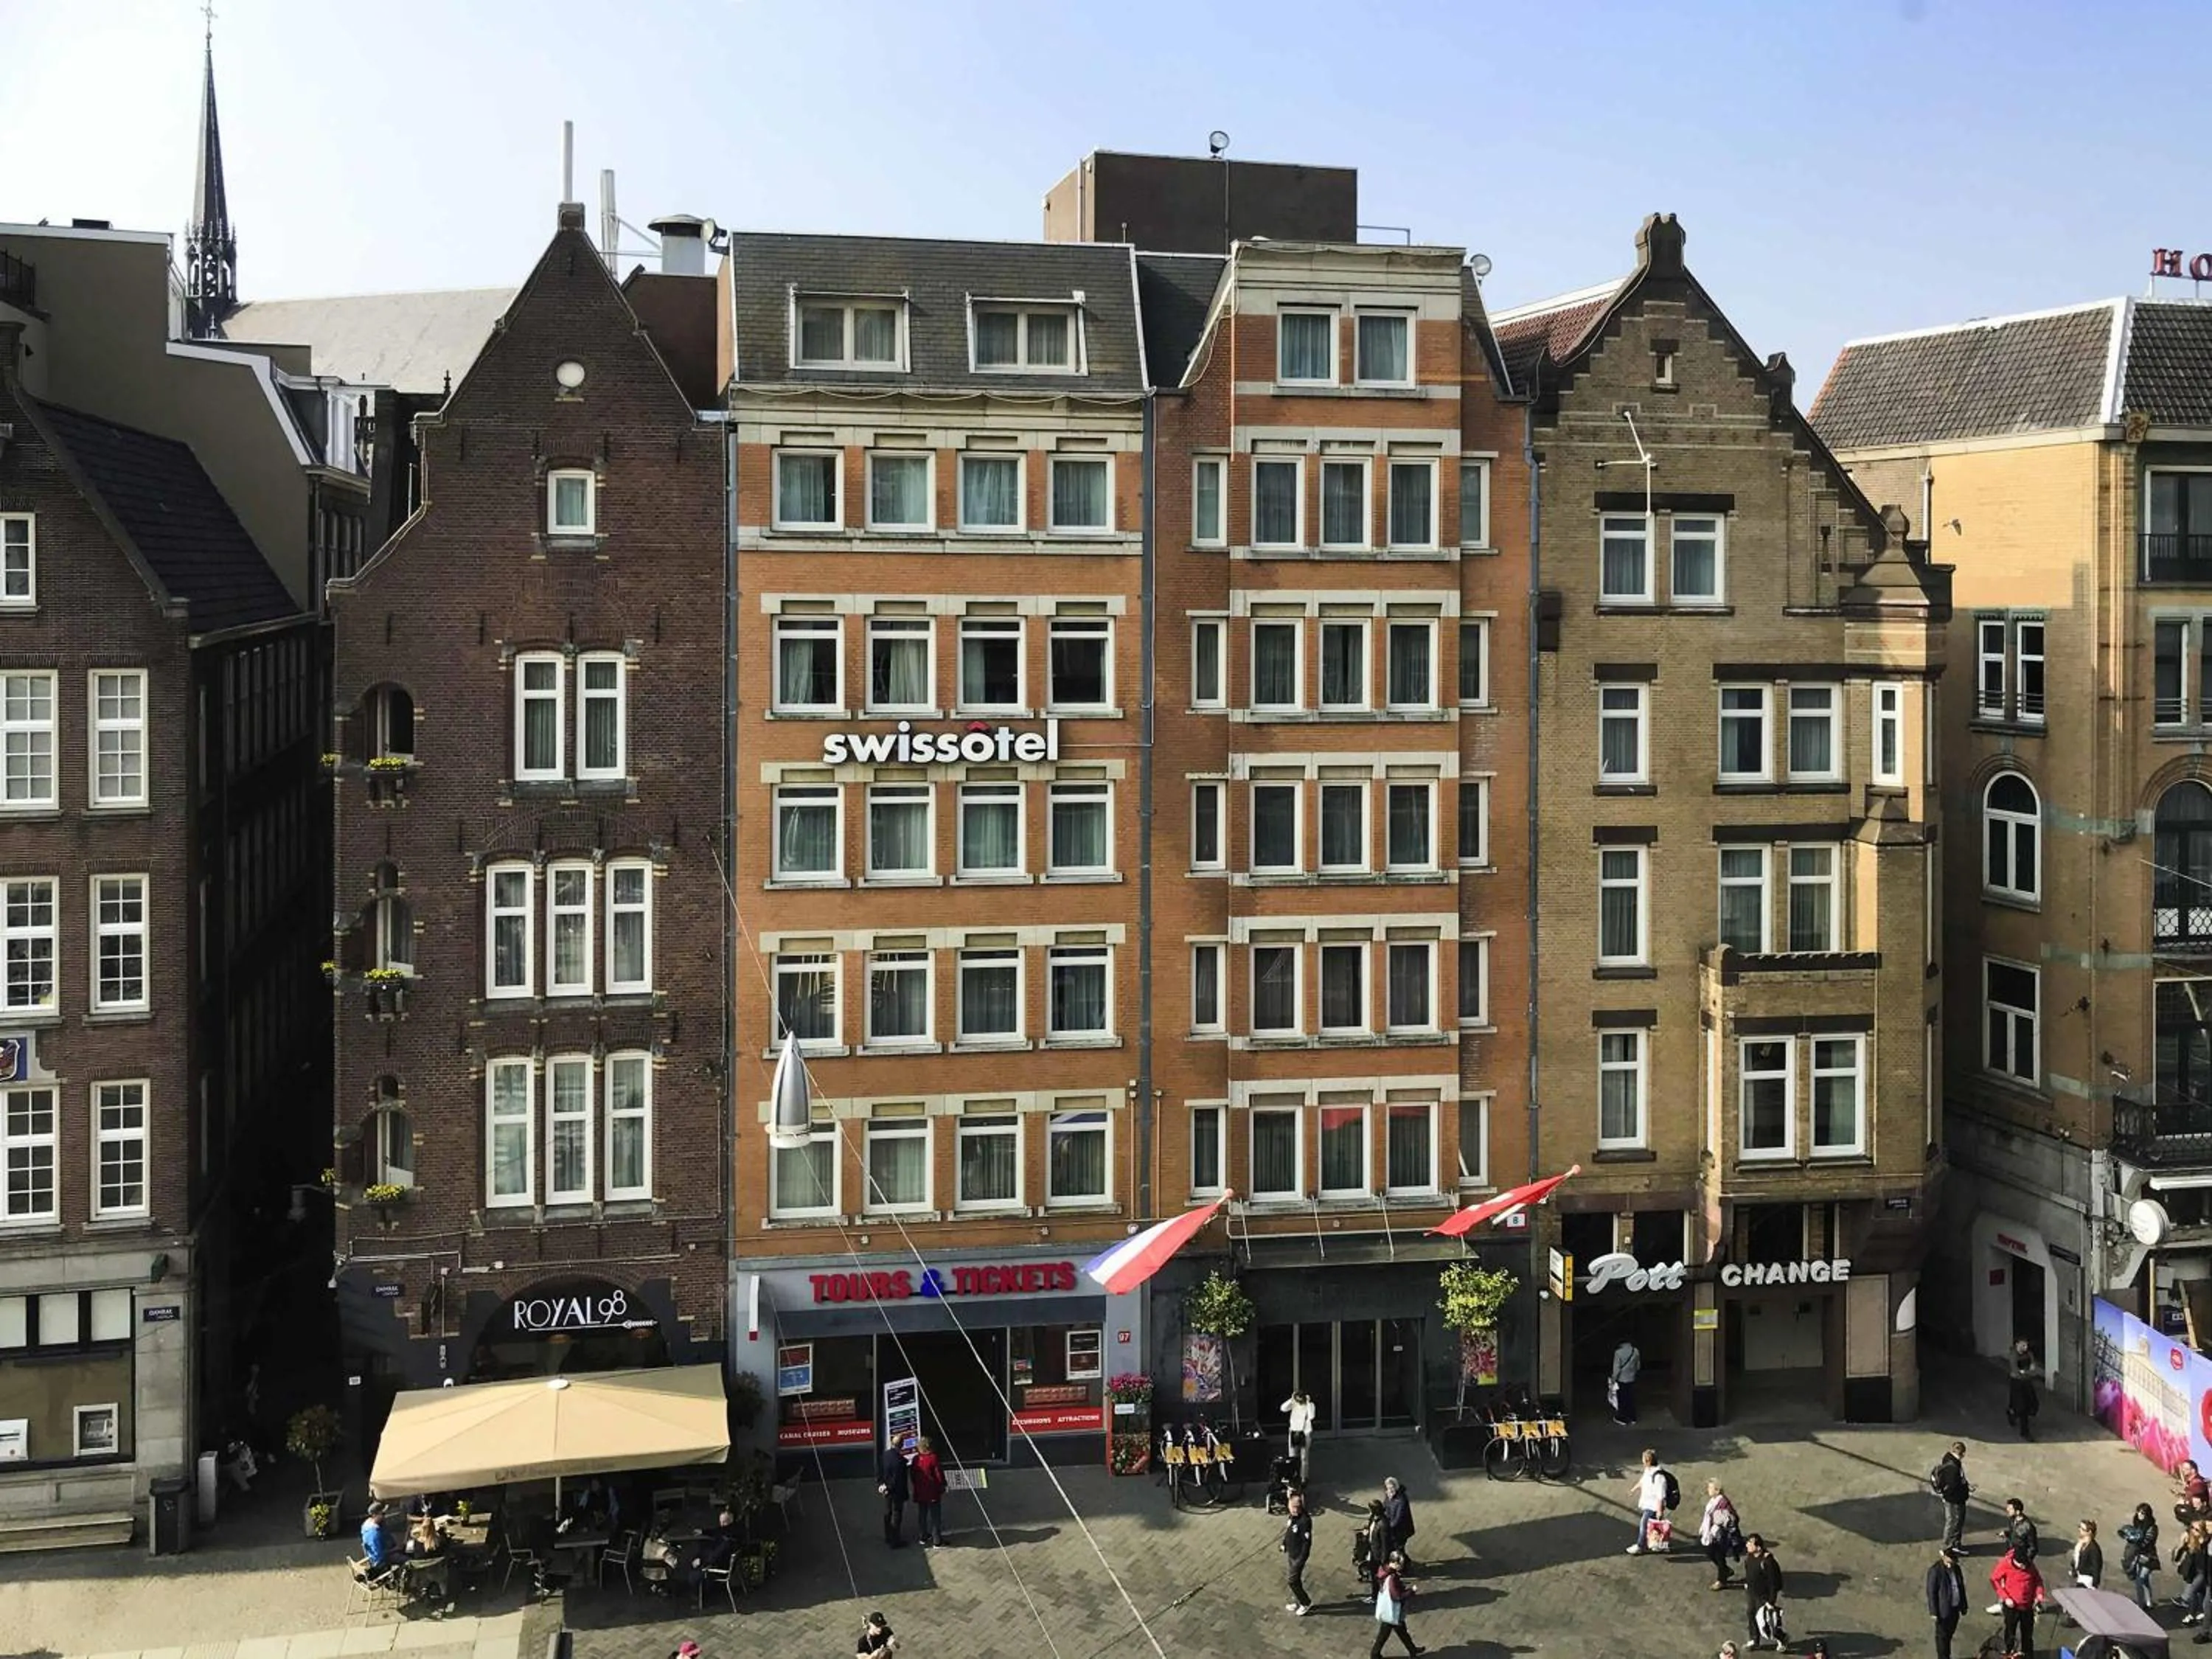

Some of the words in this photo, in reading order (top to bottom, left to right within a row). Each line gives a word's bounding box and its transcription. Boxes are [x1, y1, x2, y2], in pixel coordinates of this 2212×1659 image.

[823, 719, 1058, 764] swissôtel
[809, 1270, 912, 1304] TOURS
[919, 1268, 944, 1297] &
[952, 1262, 1077, 1296] TICKETS
[1586, 1252, 1686, 1293] Pott
[1722, 1258, 1851, 1287] CHANGE
[514, 1296, 601, 1329] ROYAL
[598, 1290, 627, 1324] 98
